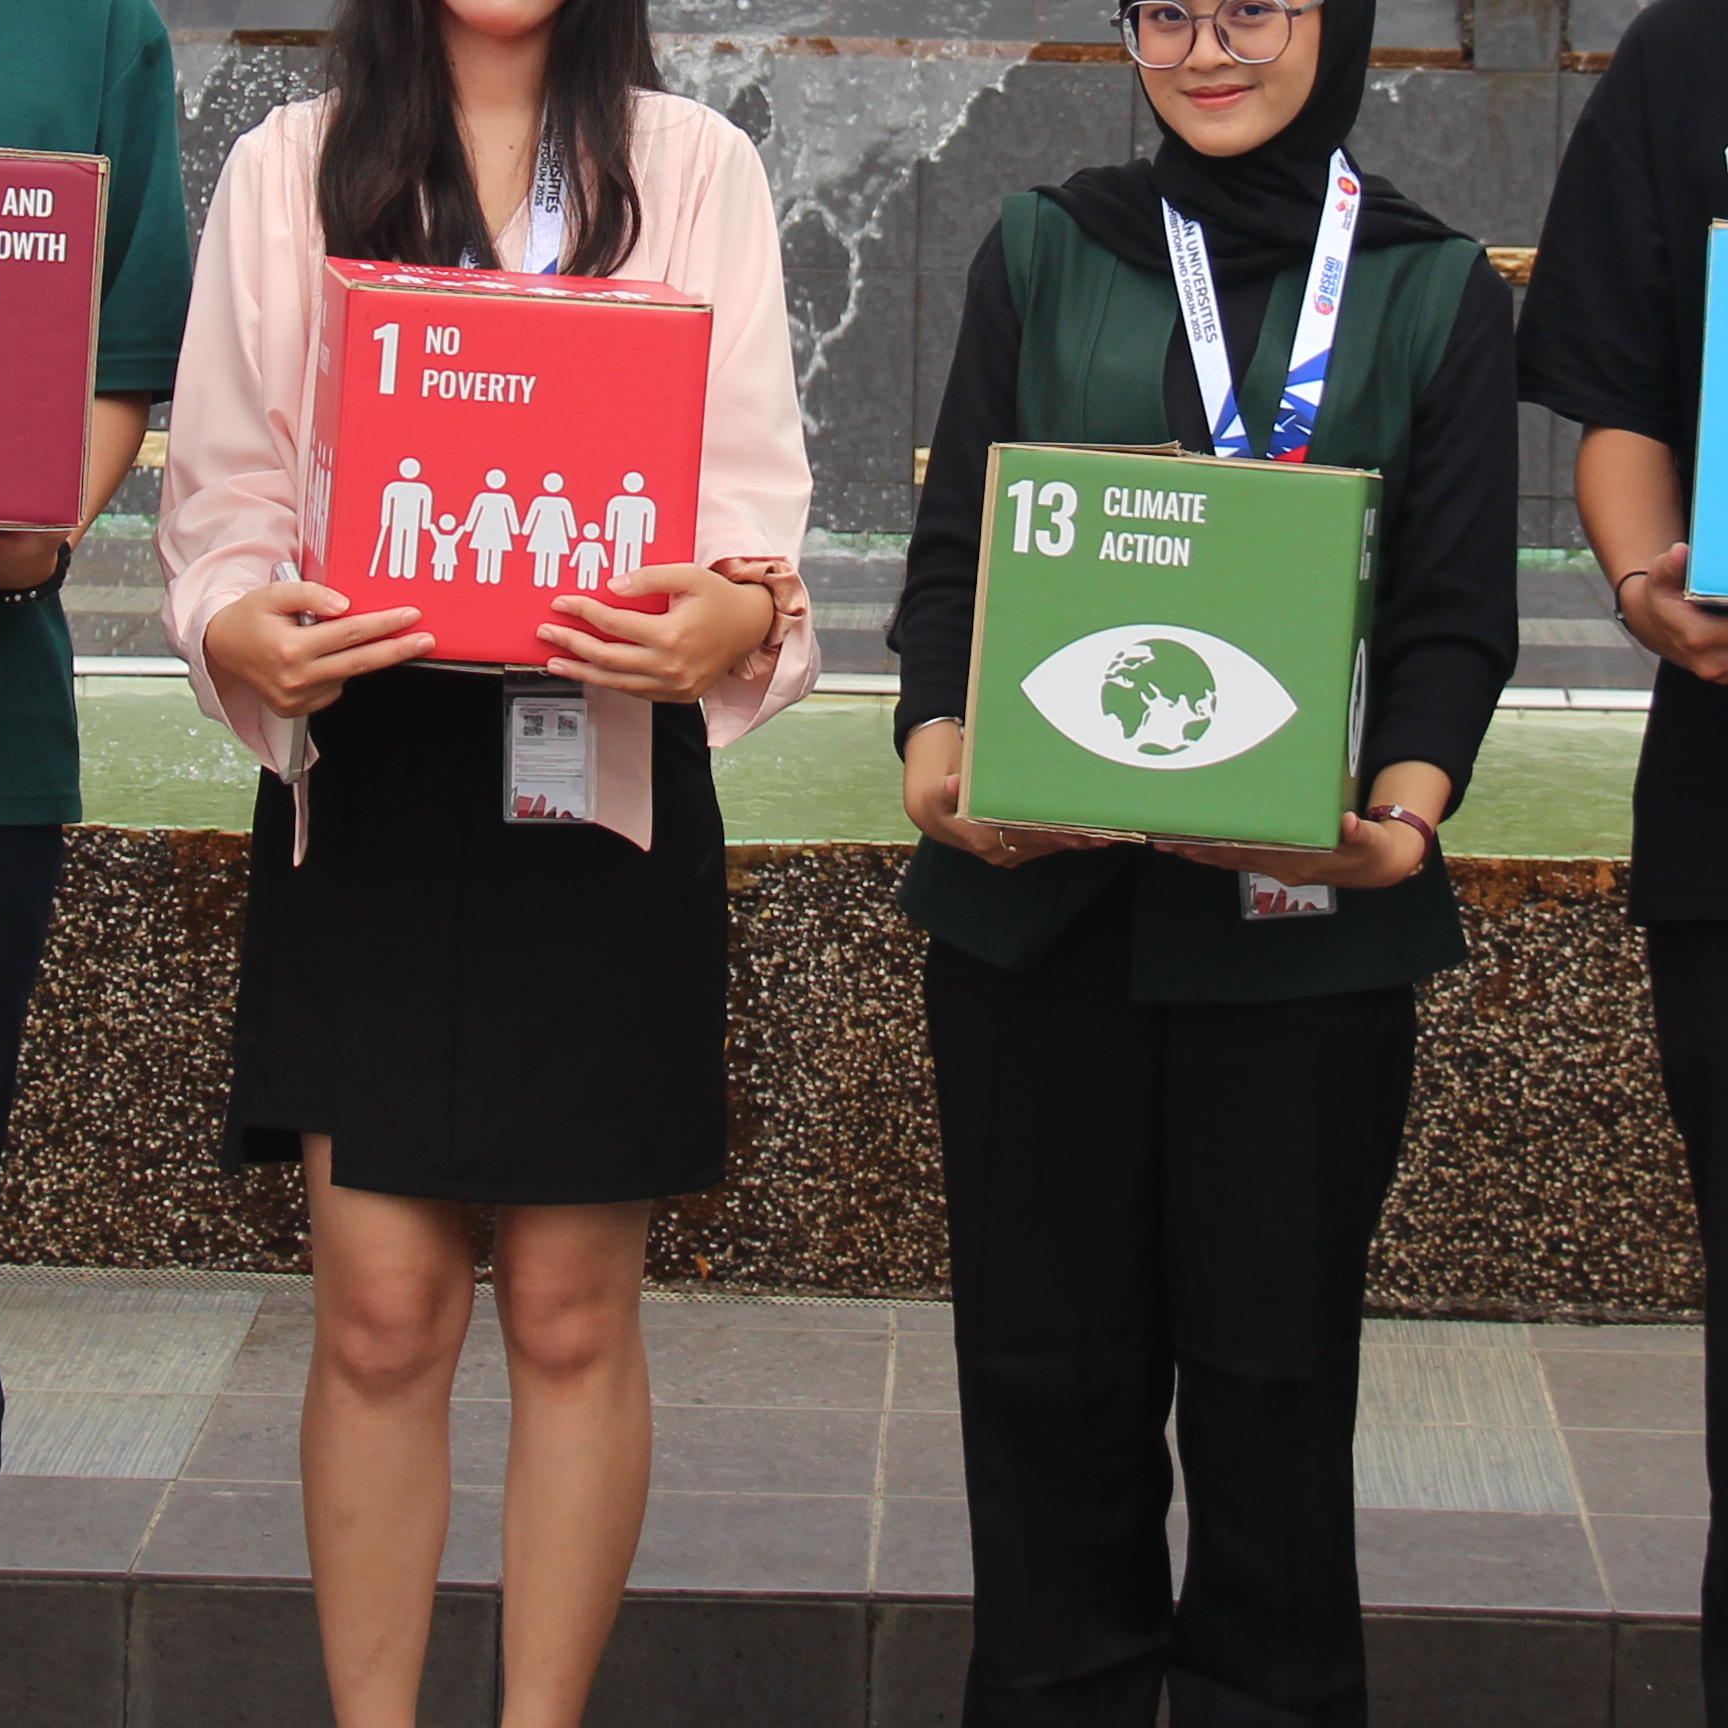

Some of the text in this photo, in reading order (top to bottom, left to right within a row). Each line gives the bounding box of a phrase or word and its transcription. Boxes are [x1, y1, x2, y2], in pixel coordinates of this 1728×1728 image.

[1, 187, 54, 218] AND
[1176, 254, 1189, 277] AND
[1190, 317, 1203, 342] 2025
[1186, 239, 1218, 343] UNIVERSITIES
[373, 322, 401, 396] 1
[424, 325, 461, 355] NO
[421, 369, 537, 404] POVERTY
[1007, 479, 1078, 557] 13
[1103, 486, 1208, 524] CLIMATE
[1098, 531, 1191, 568] ACTION
